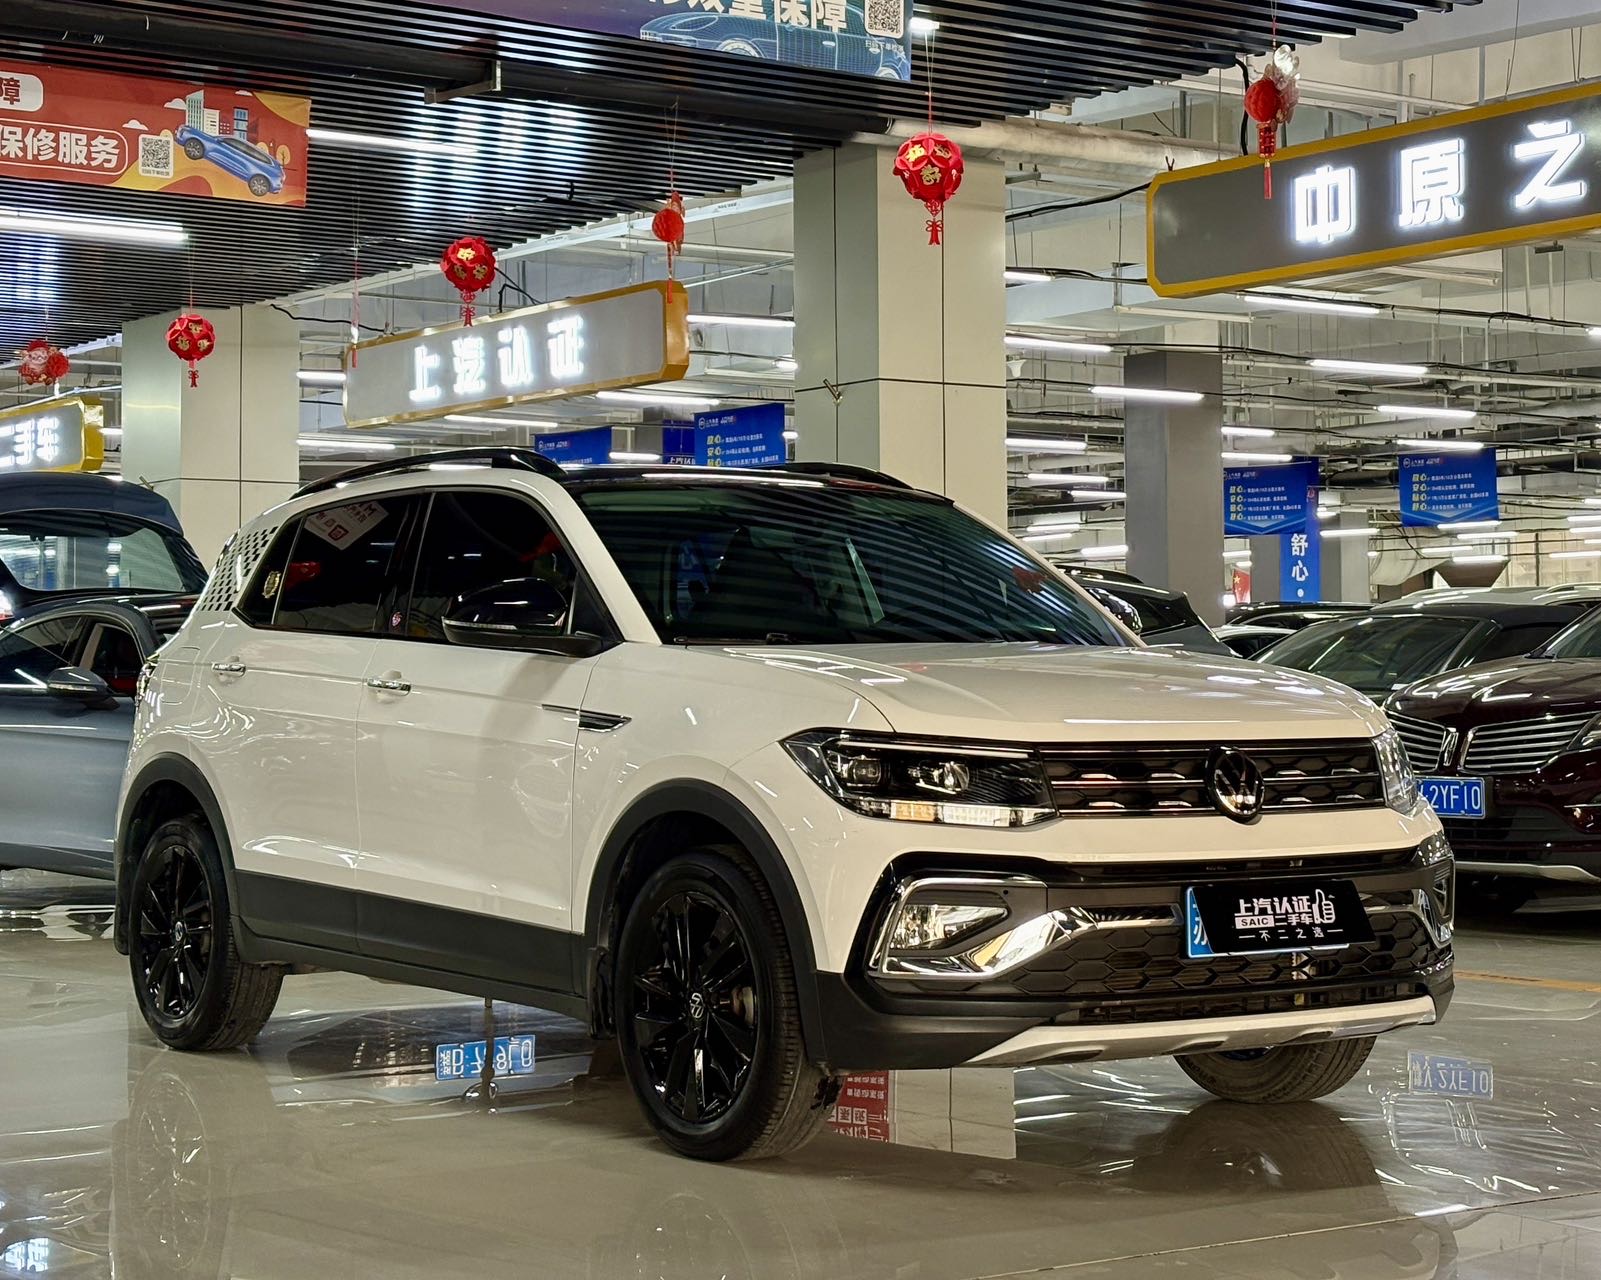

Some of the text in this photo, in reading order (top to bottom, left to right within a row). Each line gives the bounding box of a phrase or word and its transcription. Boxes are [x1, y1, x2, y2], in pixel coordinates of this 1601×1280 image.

[0, 125, 120, 168] 保修服务
[1292, 120, 1587, 245] 中原之
[1290, 532, 1309, 582] 舒心
[1234, 895, 1312, 917] 上汽认证
[1240, 913, 1314, 928] SAIC 二手车
[1260, 927, 1325, 941] 不二之选
